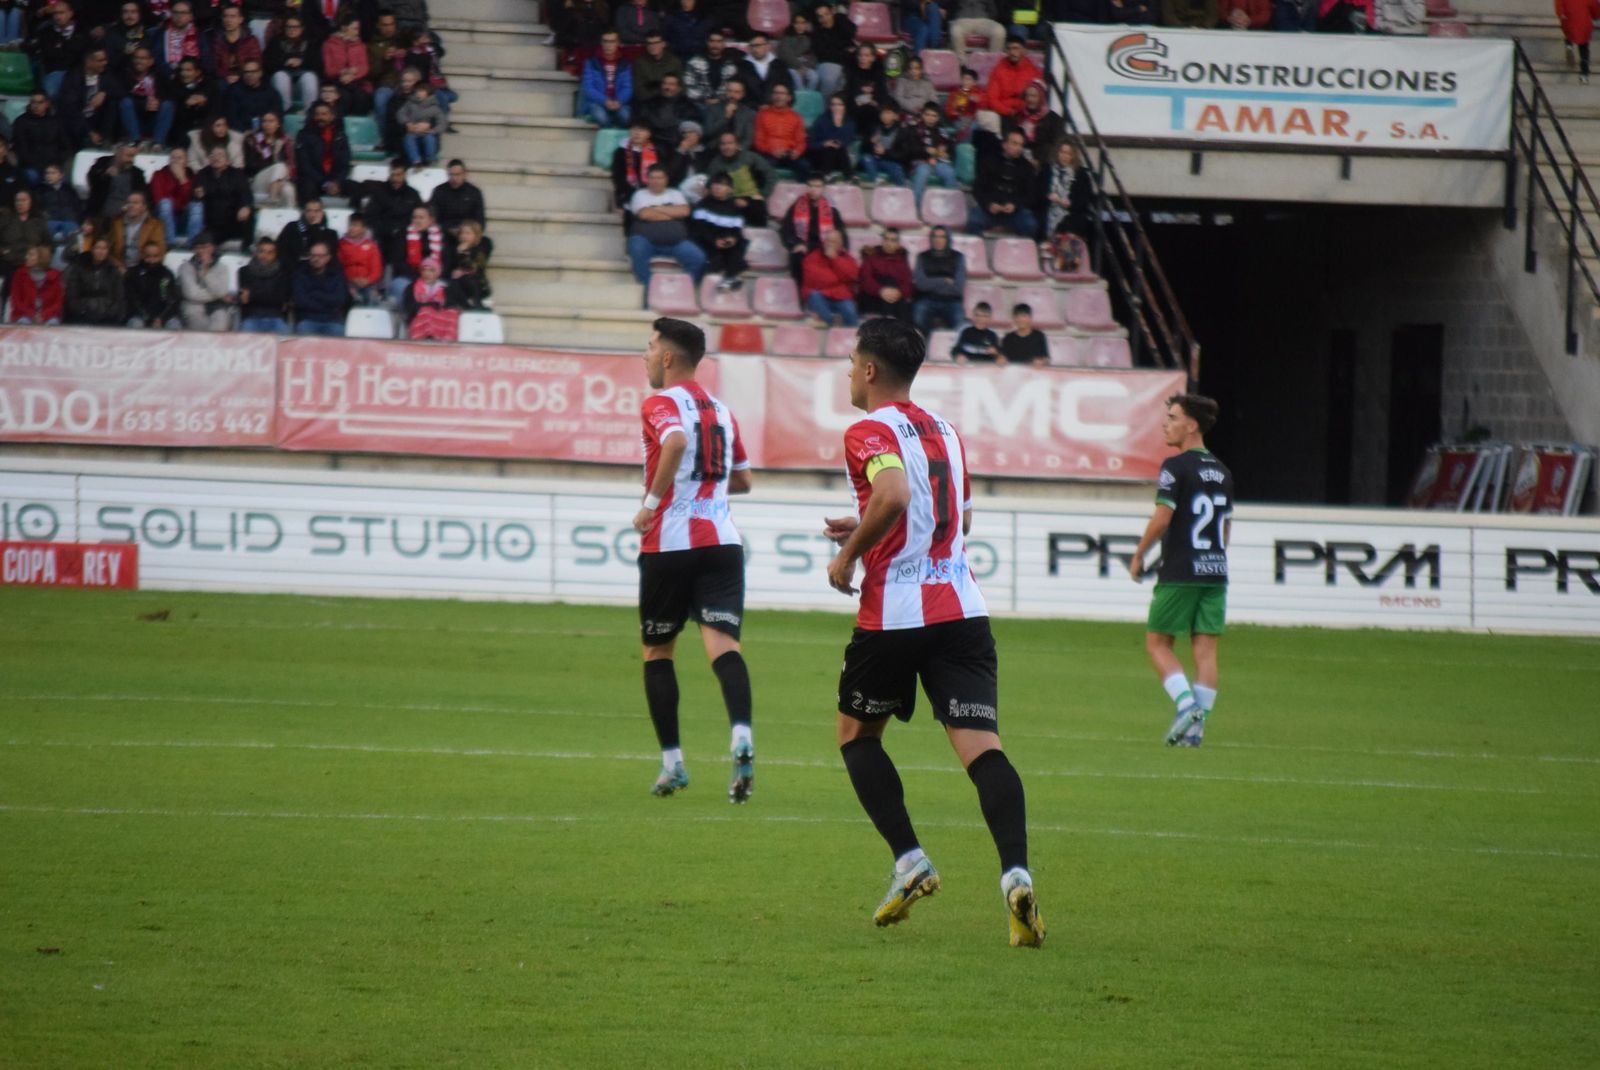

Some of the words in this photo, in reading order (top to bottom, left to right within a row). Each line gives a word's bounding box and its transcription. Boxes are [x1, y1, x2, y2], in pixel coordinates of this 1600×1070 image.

[1106, 33, 1458, 92] CONSTRUCCIONES
[1390, 121, 1449, 141] S.A.
[154, 346, 272, 373] BERNAL
[357, 364, 569, 414] Hermanos
[122, 410, 167, 432] 635
[173, 411, 217, 433] 365
[223, 412, 268, 434] 442
[690, 421, 728, 482] 10
[97, 505, 284, 552] SOLID
[308, 514, 536, 562] STUDIO
[3, 548, 56, 584] COPA
[83, 551, 122, 586] REY
[1048, 532, 1160, 579] PR
[1194, 561, 1227, 574] PASTO
[1275, 540, 1441, 589] PRM
[1379, 596, 1441, 608] RACING
